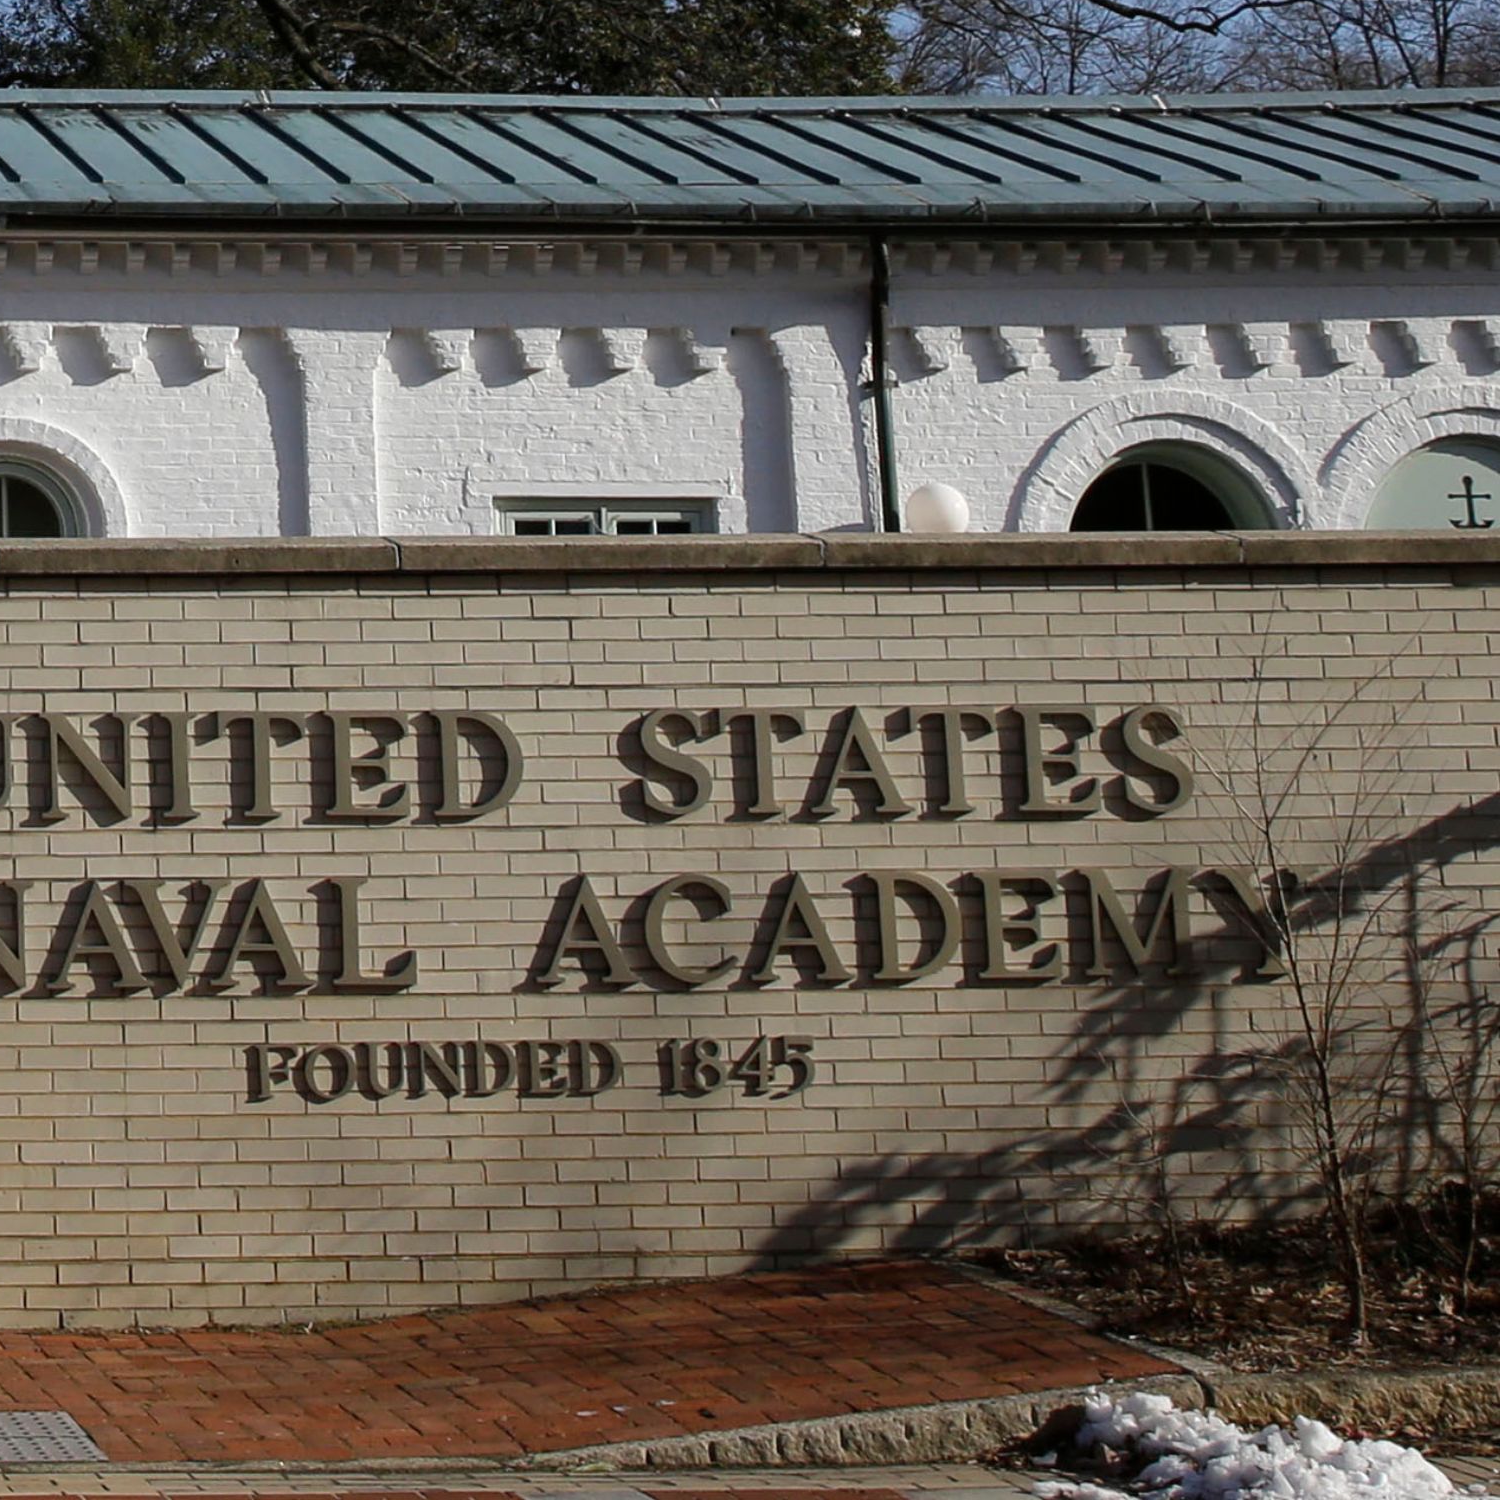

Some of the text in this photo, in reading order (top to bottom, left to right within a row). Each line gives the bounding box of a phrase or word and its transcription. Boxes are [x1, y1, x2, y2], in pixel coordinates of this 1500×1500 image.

[640, 704, 1195, 817] STATES
[535, 867, 1310, 984] ACADEMY
[254, 1034, 816, 1101] FOUNDED 1845
